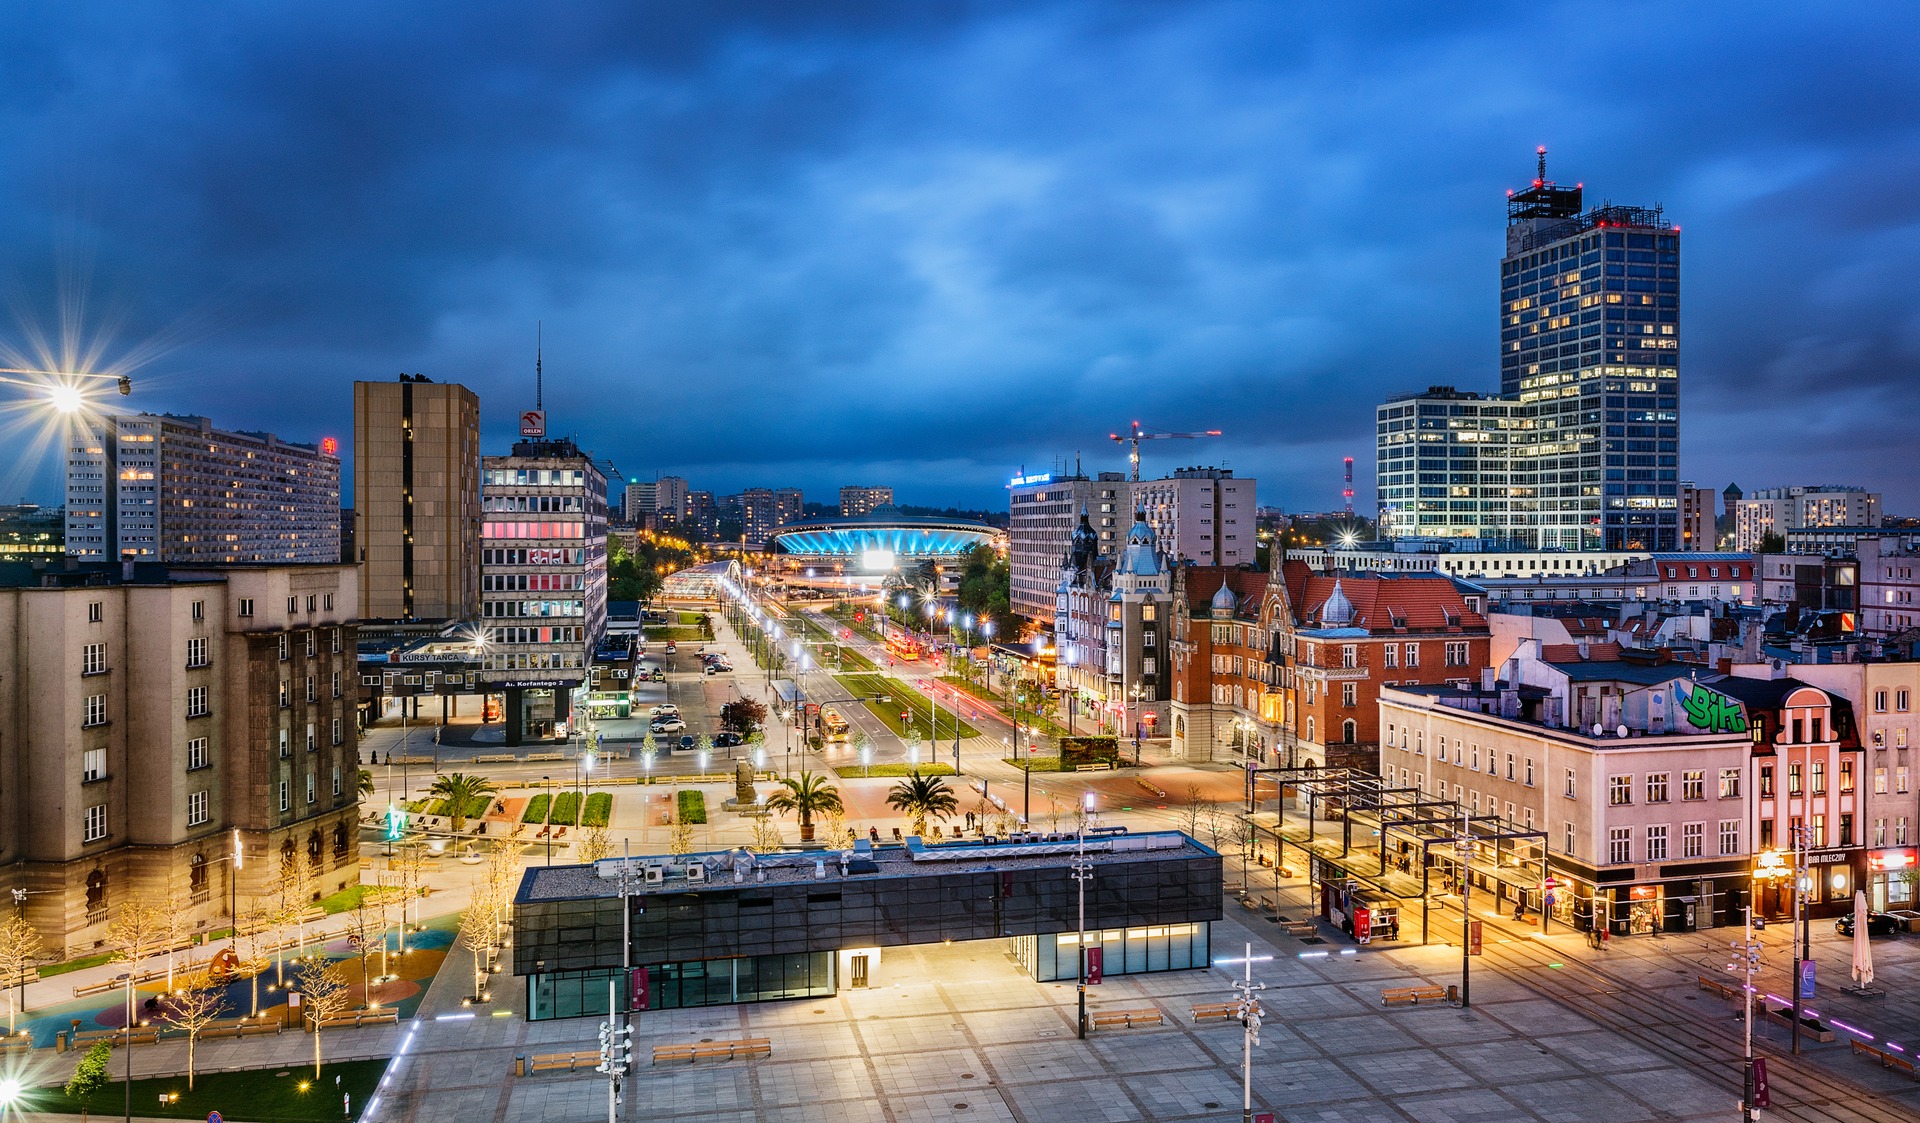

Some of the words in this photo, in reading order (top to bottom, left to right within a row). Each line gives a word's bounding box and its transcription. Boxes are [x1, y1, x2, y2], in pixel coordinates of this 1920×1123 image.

[432, 653, 459, 661] TAŃCA
[1808, 855, 1820, 864] BAR
[1820, 853, 1846, 863] MLECZNY
